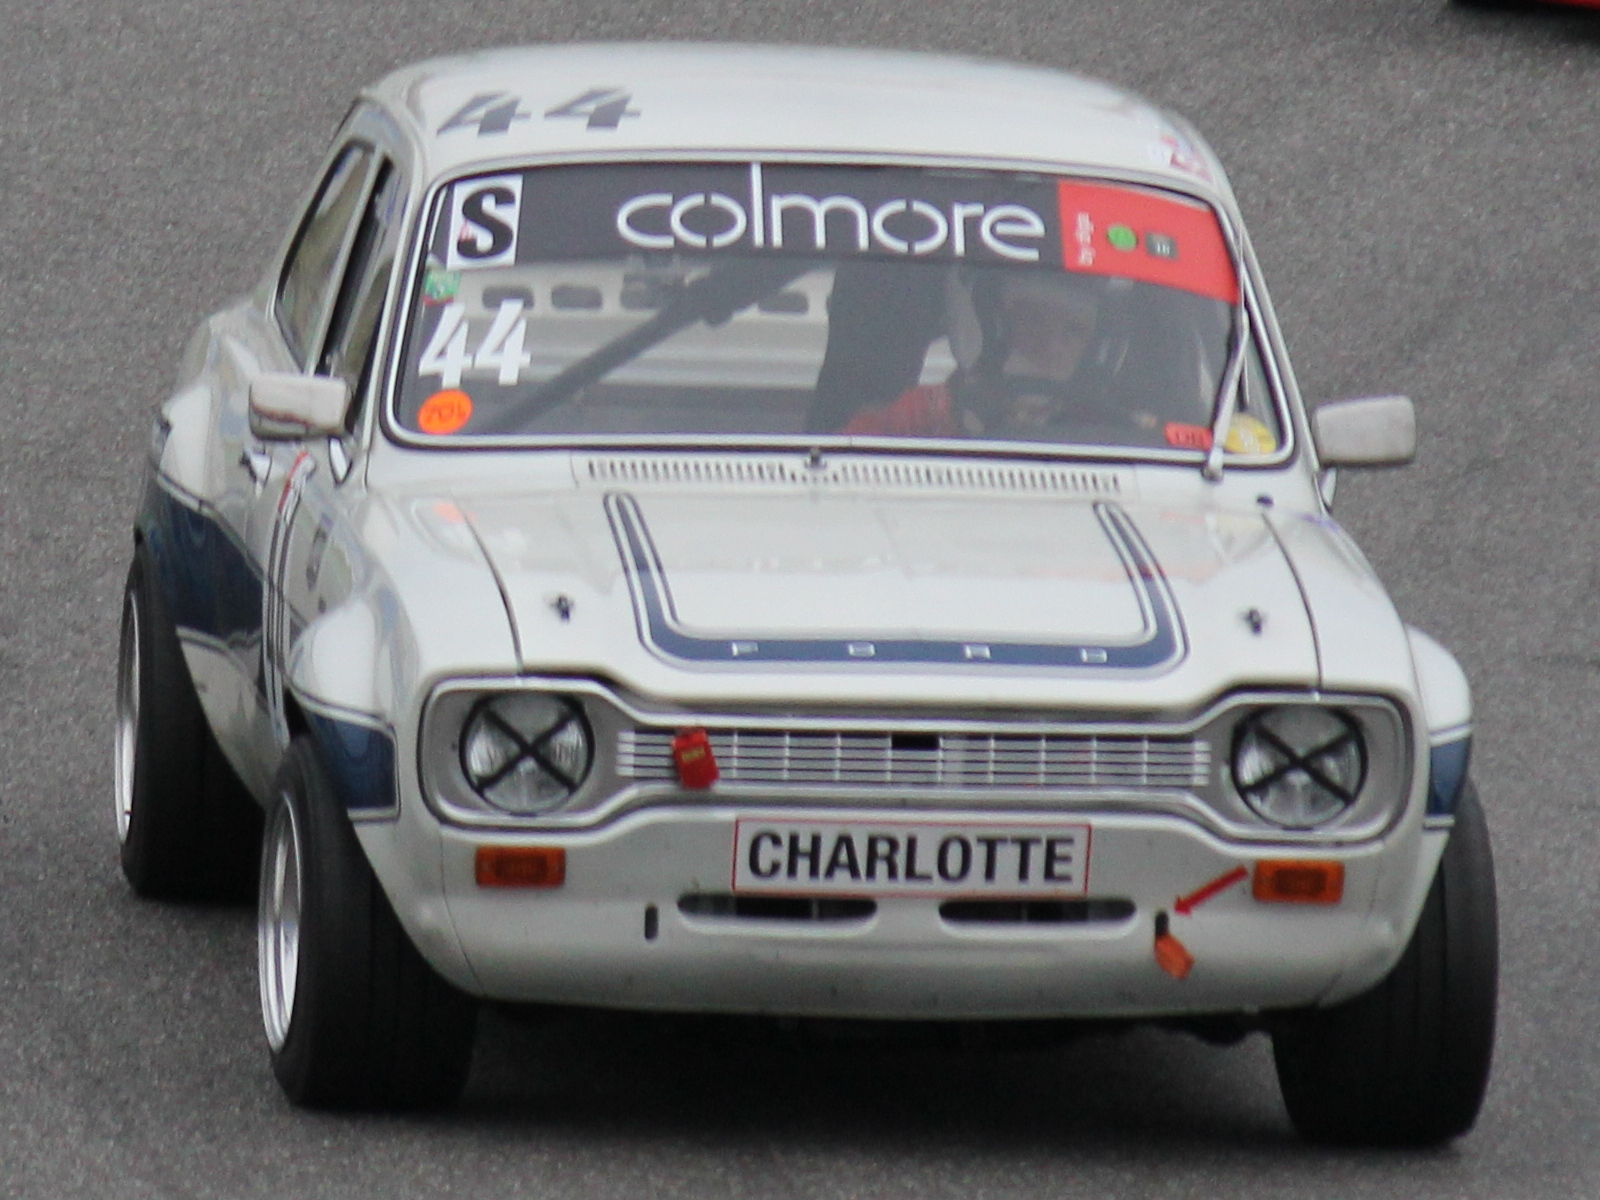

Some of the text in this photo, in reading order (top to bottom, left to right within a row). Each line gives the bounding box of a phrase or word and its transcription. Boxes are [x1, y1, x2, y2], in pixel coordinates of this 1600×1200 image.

[437, 88, 641, 136] 44
[457, 187, 515, 258] S
[616, 163, 1045, 261] colmore
[419, 298, 531, 389] 44
[748, 831, 1074, 882] CHARLOTTE
